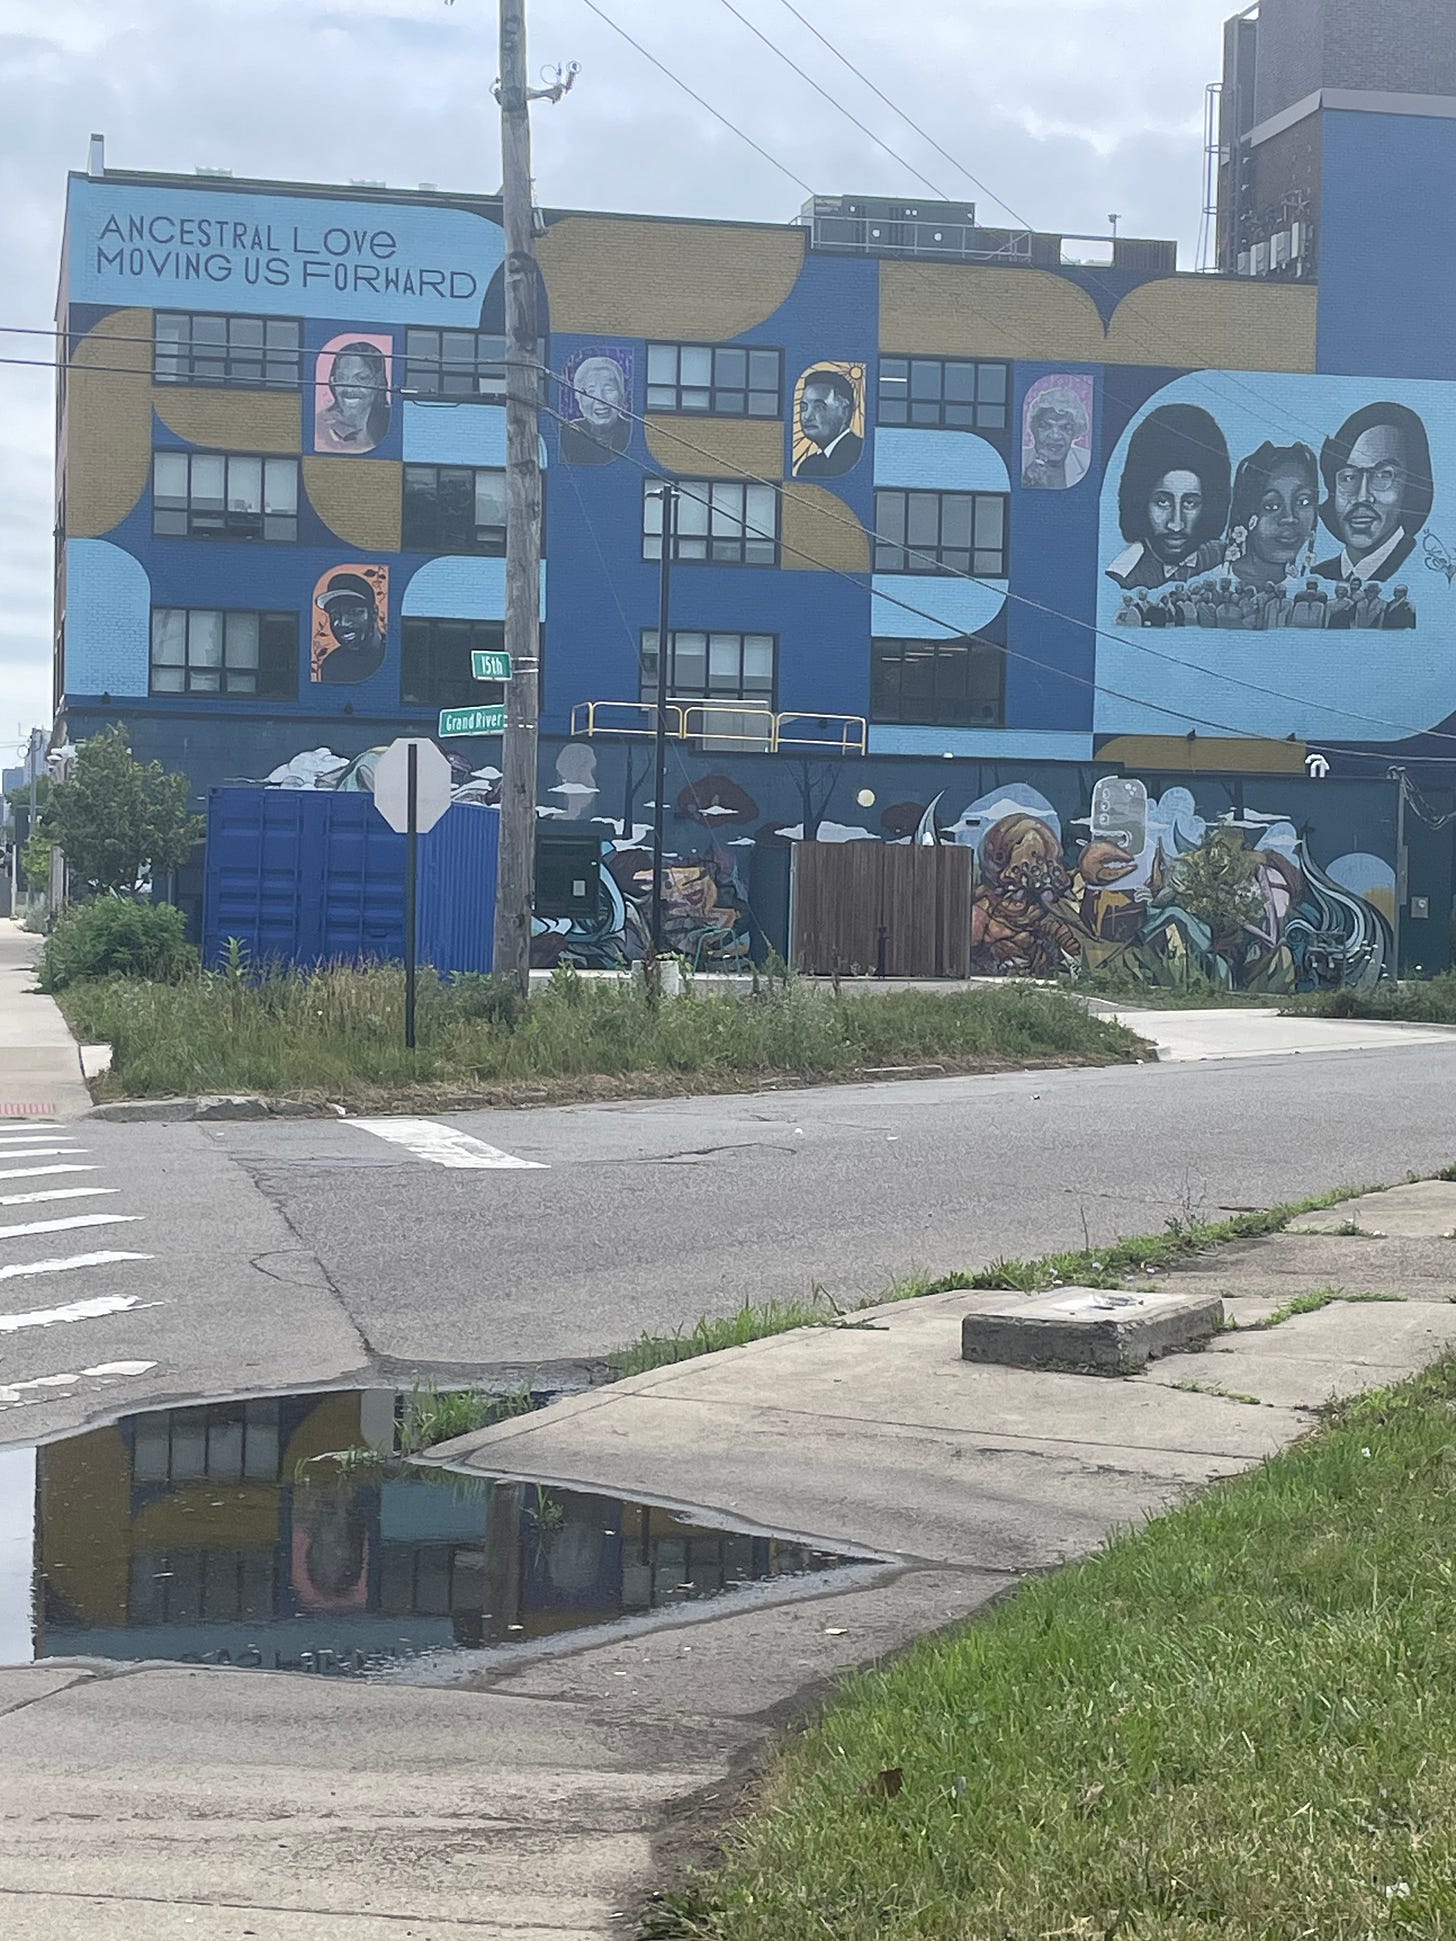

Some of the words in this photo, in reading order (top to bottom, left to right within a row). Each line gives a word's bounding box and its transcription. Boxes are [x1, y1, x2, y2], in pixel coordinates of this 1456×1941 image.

[100, 213, 279, 252] ANCESTRAL
[97, 246, 232, 282] MOVING
[245, 257, 289, 286] US
[303, 260, 477, 299] FORWARD
[481, 655, 503, 675] 15th
[446, 715, 474, 731] Grand
[475, 711, 502, 728] River
